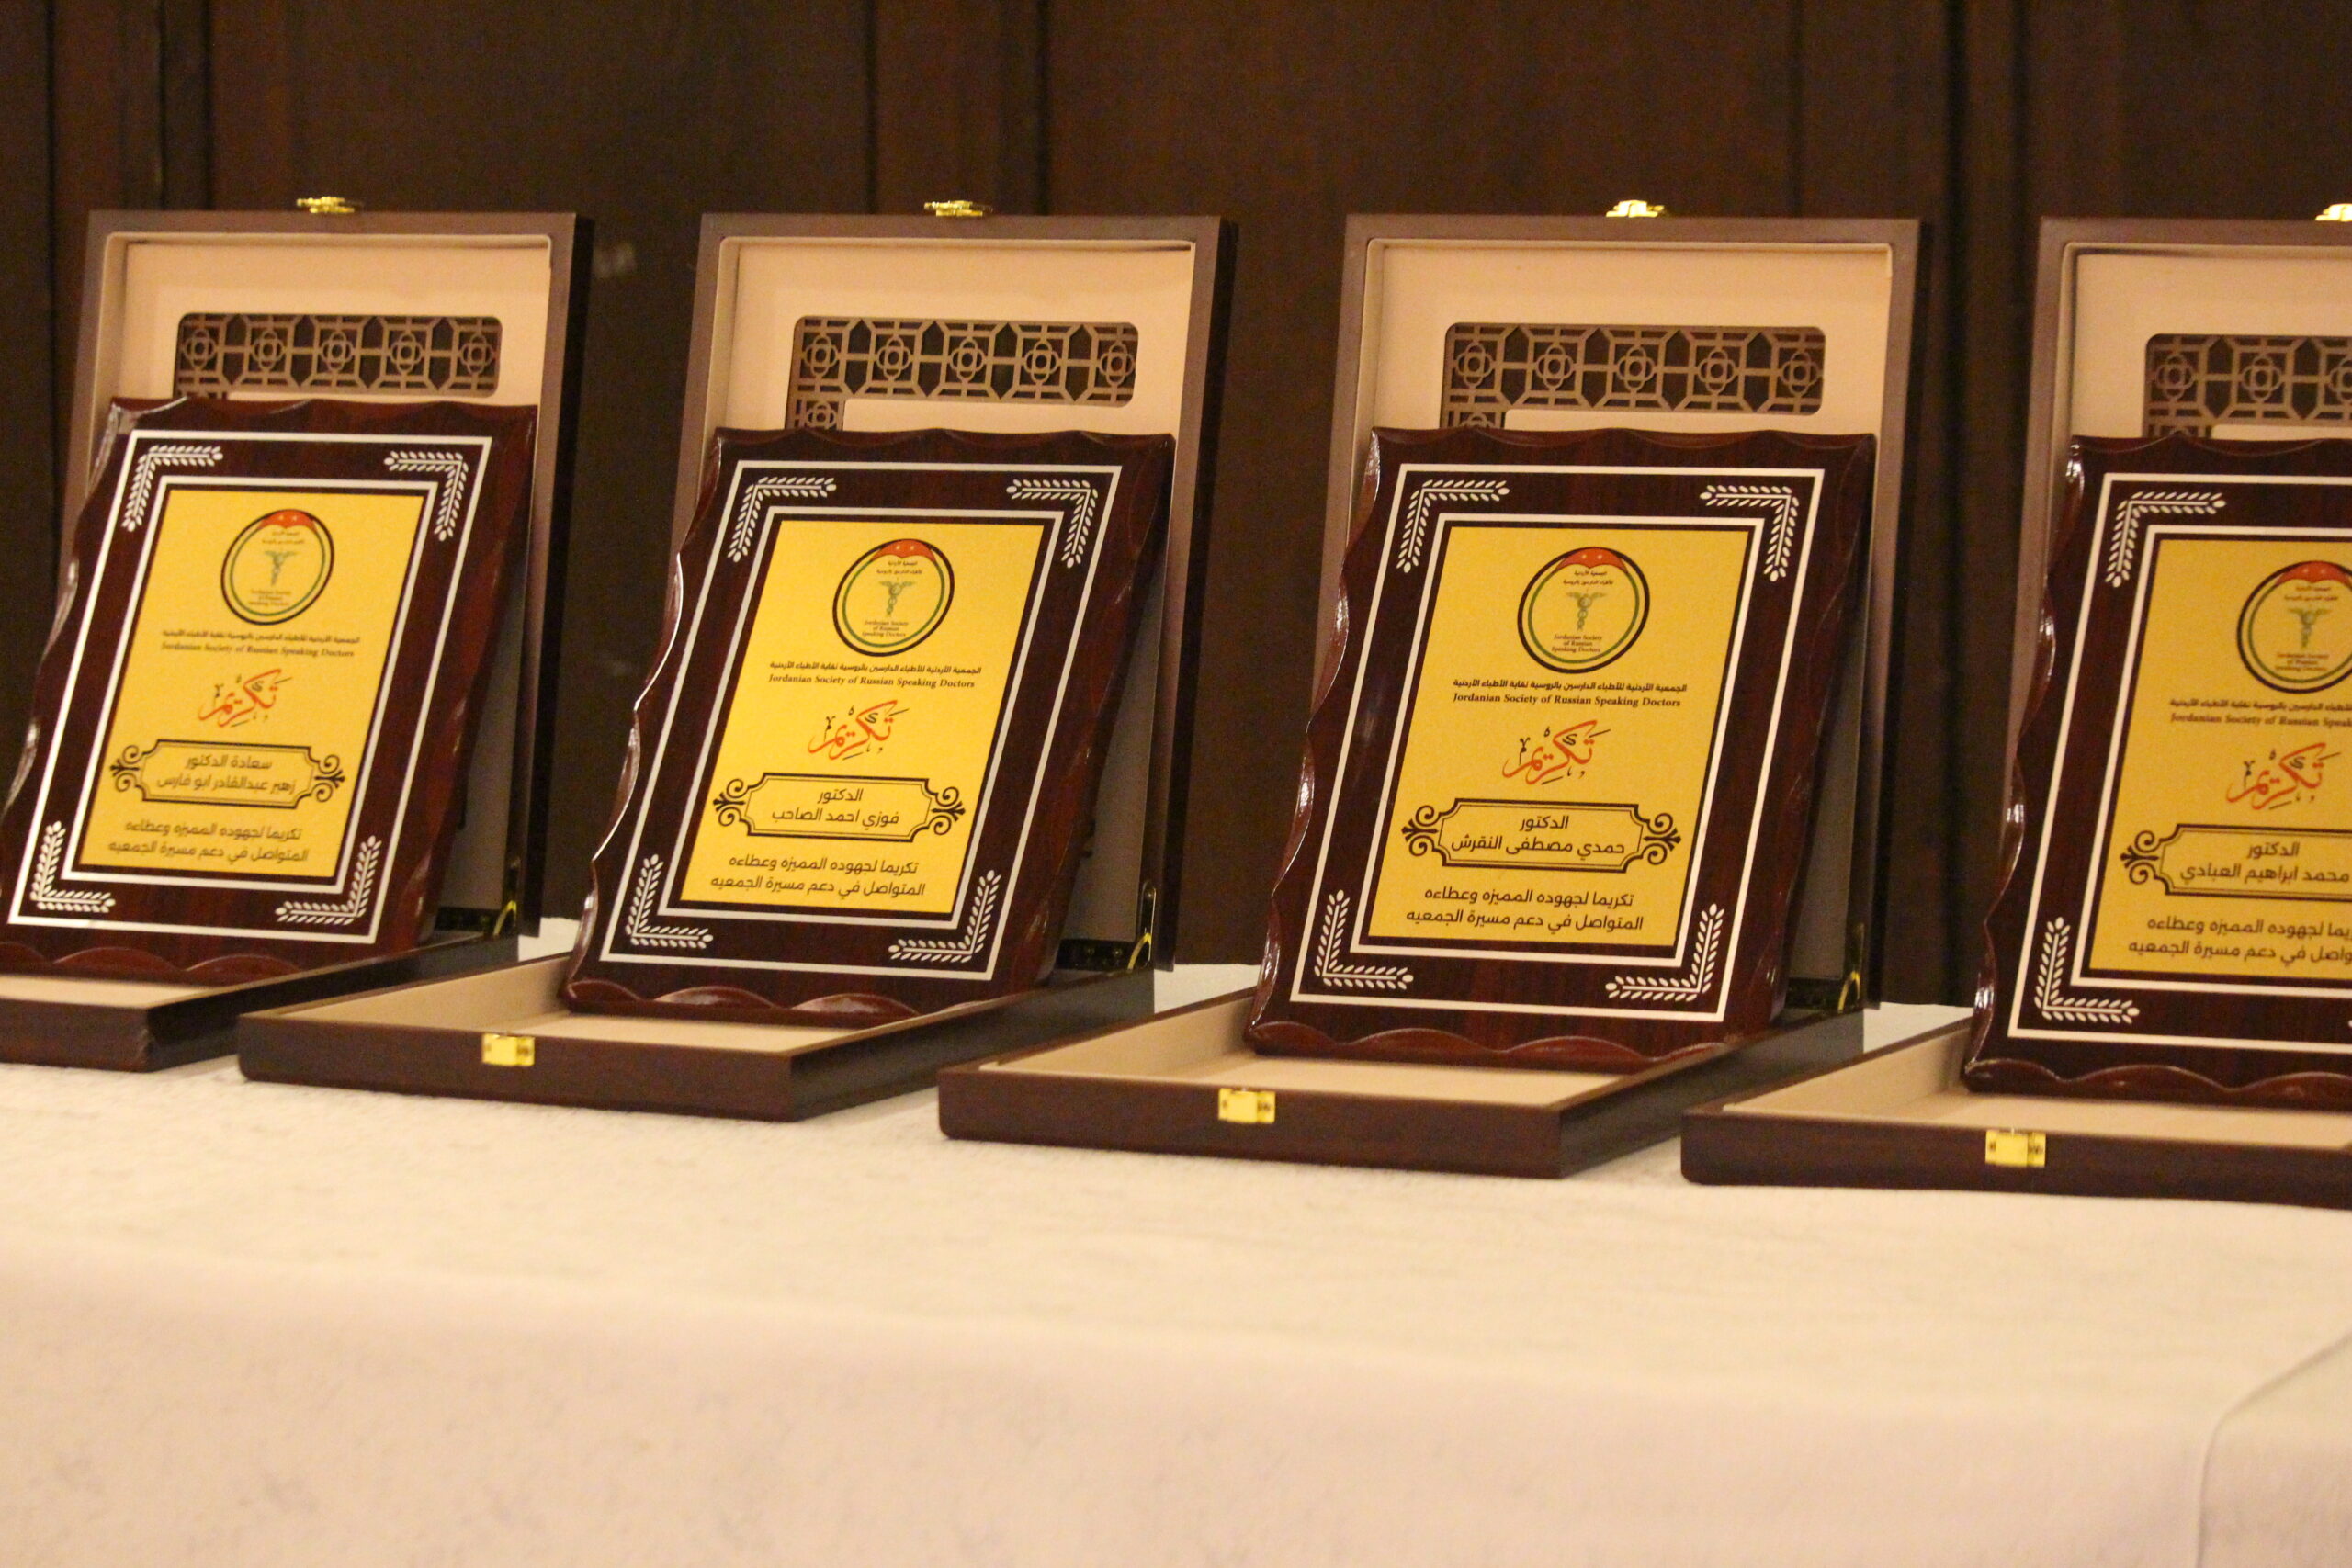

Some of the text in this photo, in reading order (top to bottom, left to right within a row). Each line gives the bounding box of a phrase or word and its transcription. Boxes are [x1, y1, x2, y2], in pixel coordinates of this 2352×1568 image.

[768, 674, 812, 682] Jordanian
[816, 676, 845, 684] Society
[860, 677, 894, 685] Russian
[897, 678, 936, 689] Speaking
[940, 680, 975, 688] Doctors
[1453, 678, 1479, 688] الأردنية
[1655, 683, 1687, 693] الجمعية
[1453, 693, 1680, 707] Jordanian Society of Russian Speaking Doctors
[818, 788, 863, 804] الدكتور
[772, 807, 899, 830] فوزي احمد الصاحب
[1520, 816, 1569, 831] الدكتور
[1451, 834, 1625, 860] حمدي مصطفى النقرش
[2247, 842, 2300, 860] الدكتور
[729, 853, 919, 877] تكريما لجهوده المميزه وعطاءه
[2179, 863, 2350, 885] محمد ابراهيم العبادي
[711, 876, 925, 899] المتواصل في دعم مسيرة الجمعيه
[1425, 886, 1634, 909] تكريما لجهوده المميزه وعطاءه
[1407, 908, 1644, 934] المتواصل في دعم مسيرة الجمعيه
[2148, 915, 2204, 933] وعطاءه
[2210, 919, 2264, 935] المميزه
[2267, 920, 2324, 938] لجهوده
[2129, 940, 2189, 956] الجمعيه
[2194, 941, 2240, 959] مسيرة
[2244, 944, 2276, 961] دعم
[2280, 943, 2306, 966] في
